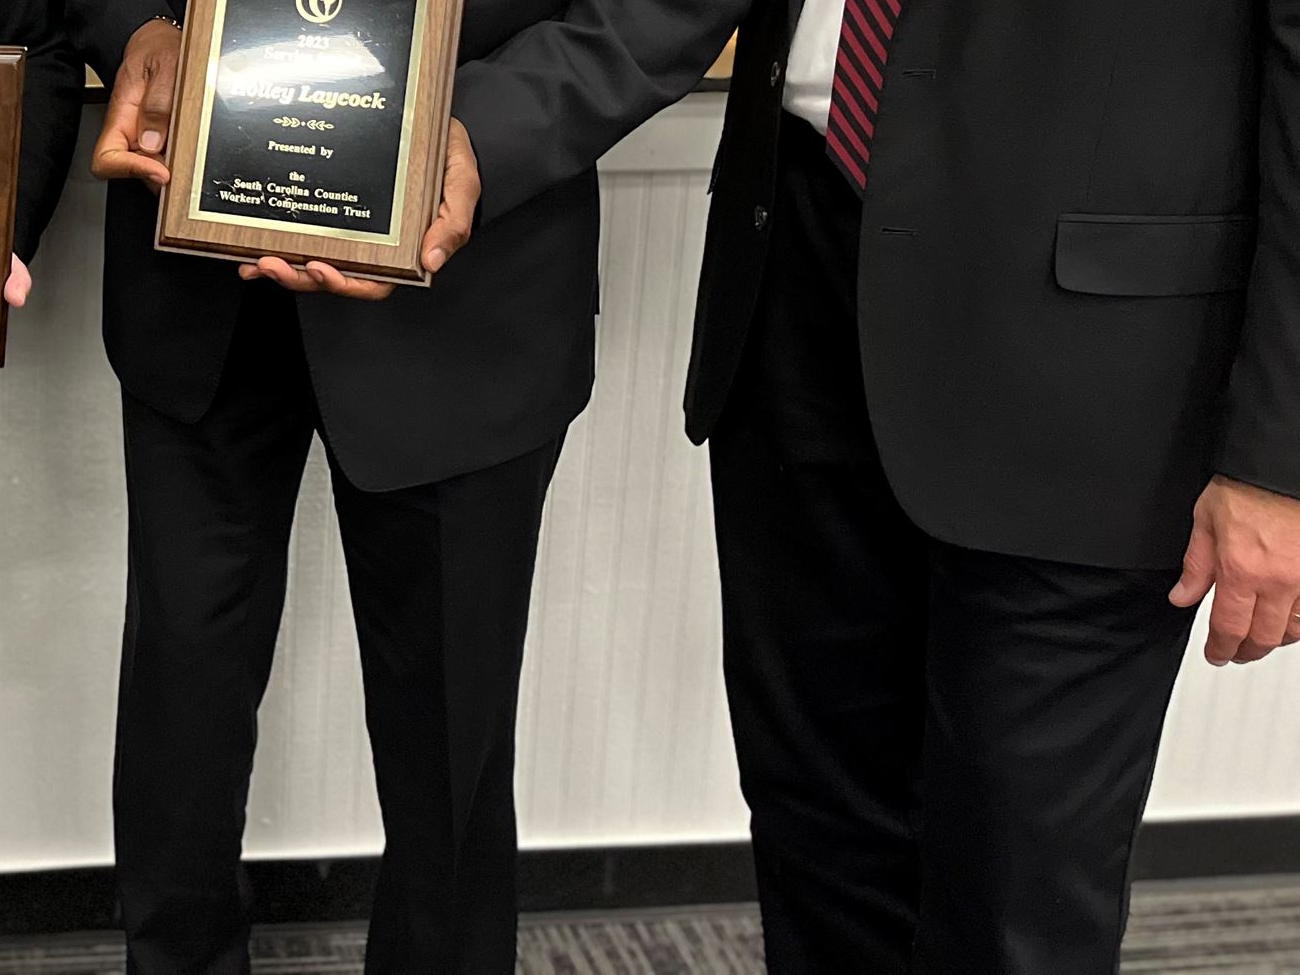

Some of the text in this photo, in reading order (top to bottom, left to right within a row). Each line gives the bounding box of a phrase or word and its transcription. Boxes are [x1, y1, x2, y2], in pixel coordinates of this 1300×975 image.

[298, 85, 387, 110] Laycock
[267, 140, 334, 159] Presented by
[288, 171, 306, 182] the
[233, 178, 358, 202] South Carolina Counties
[219, 190, 371, 219] Workers' Compensation Trust
